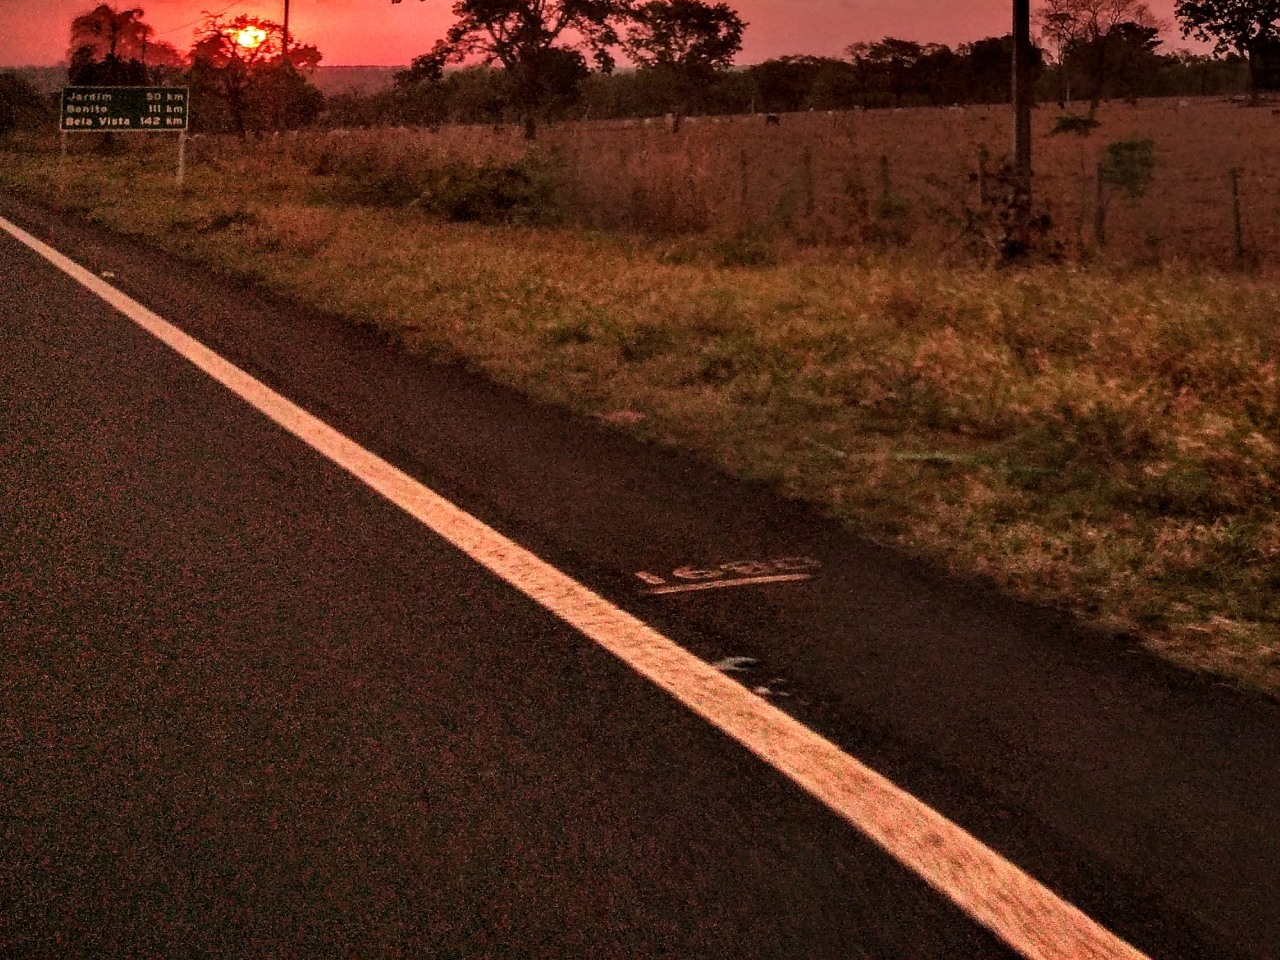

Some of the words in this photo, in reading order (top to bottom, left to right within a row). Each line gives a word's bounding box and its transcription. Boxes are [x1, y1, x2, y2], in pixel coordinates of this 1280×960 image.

[146, 92, 161, 101] 50
[166, 92, 183, 101] km
[166, 104, 183, 113] km
[99, 117, 130, 126] Vista
[140, 116, 161, 125] 142
